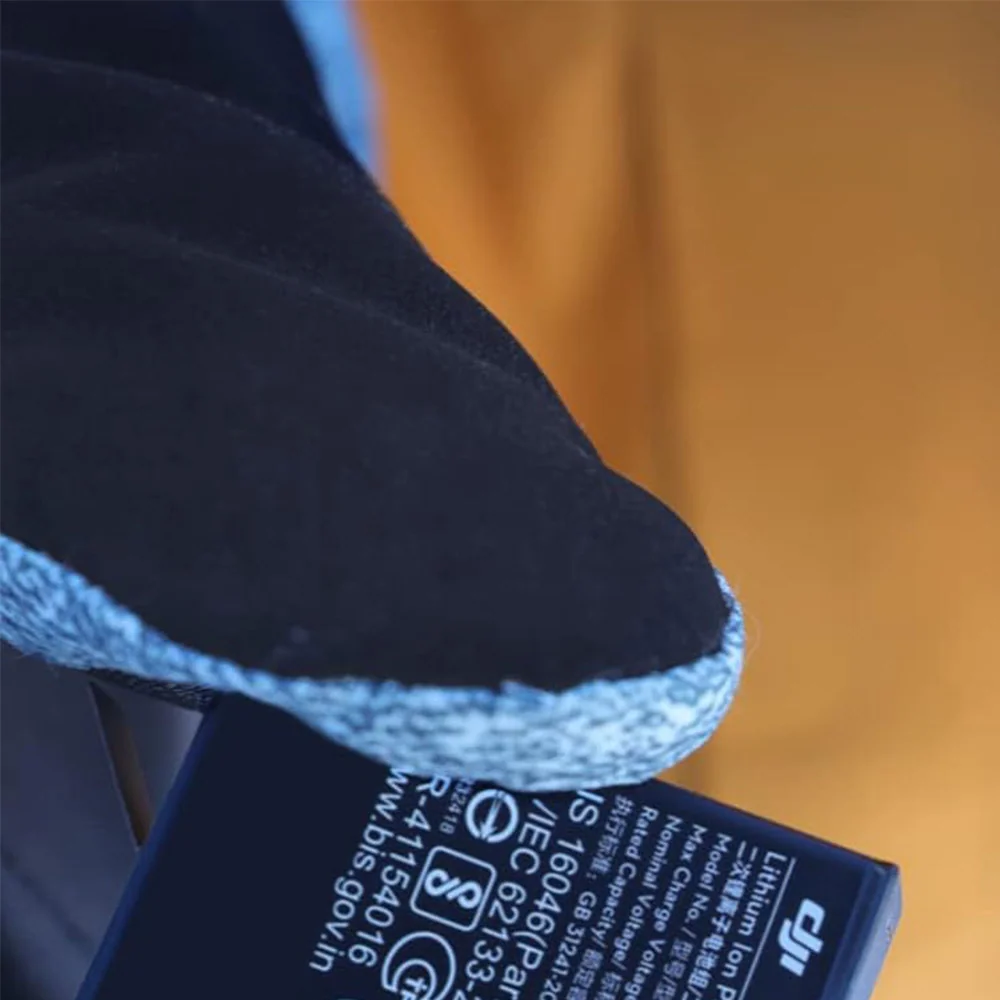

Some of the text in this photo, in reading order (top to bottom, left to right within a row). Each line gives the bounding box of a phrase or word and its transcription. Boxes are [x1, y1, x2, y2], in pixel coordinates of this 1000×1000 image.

[509, 799, 558, 875] /IEC
[568, 785, 605, 826] IS
[625, 805, 659, 860] Rated
[348, 766, 452, 967] R-41154016
[642, 815, 683, 890] Nominal
[680, 824, 708, 861] Max
[698, 833, 732, 891] Model
[573, 891, 597, 921] GB
[590, 862, 637, 948] Capacity/
[653, 866, 692, 932] Charge
[684, 893, 710, 923] No.
[738, 851, 787, 936] Lithium
[611, 895, 655, 970] Voltage/
[721, 942, 753, 978] Ion
[777, 898, 825, 977] dji
